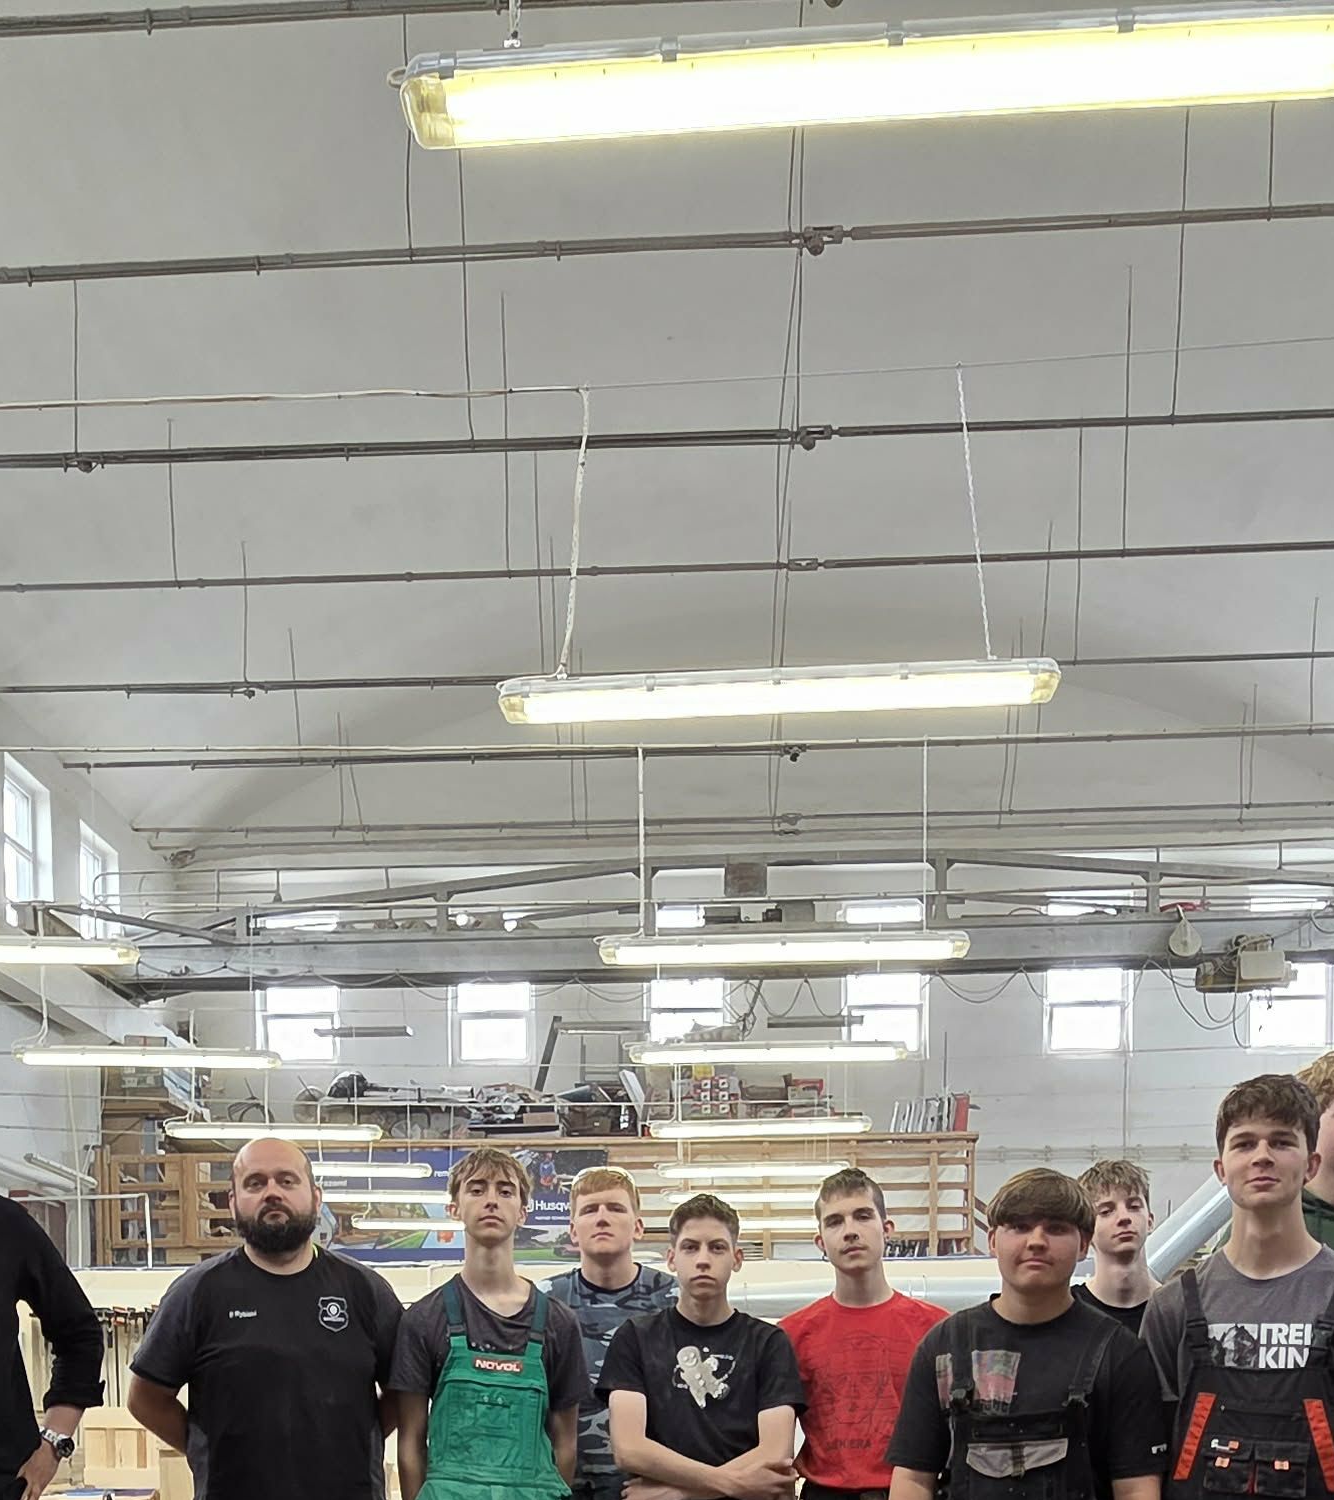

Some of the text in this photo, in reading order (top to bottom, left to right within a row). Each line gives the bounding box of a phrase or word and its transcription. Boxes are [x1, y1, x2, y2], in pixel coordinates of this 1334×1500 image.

[535, 1199, 572, 1213] Husqv
[1258, 1346, 1310, 1369] KIN
[475, 1359, 521, 1373] NOVOL
